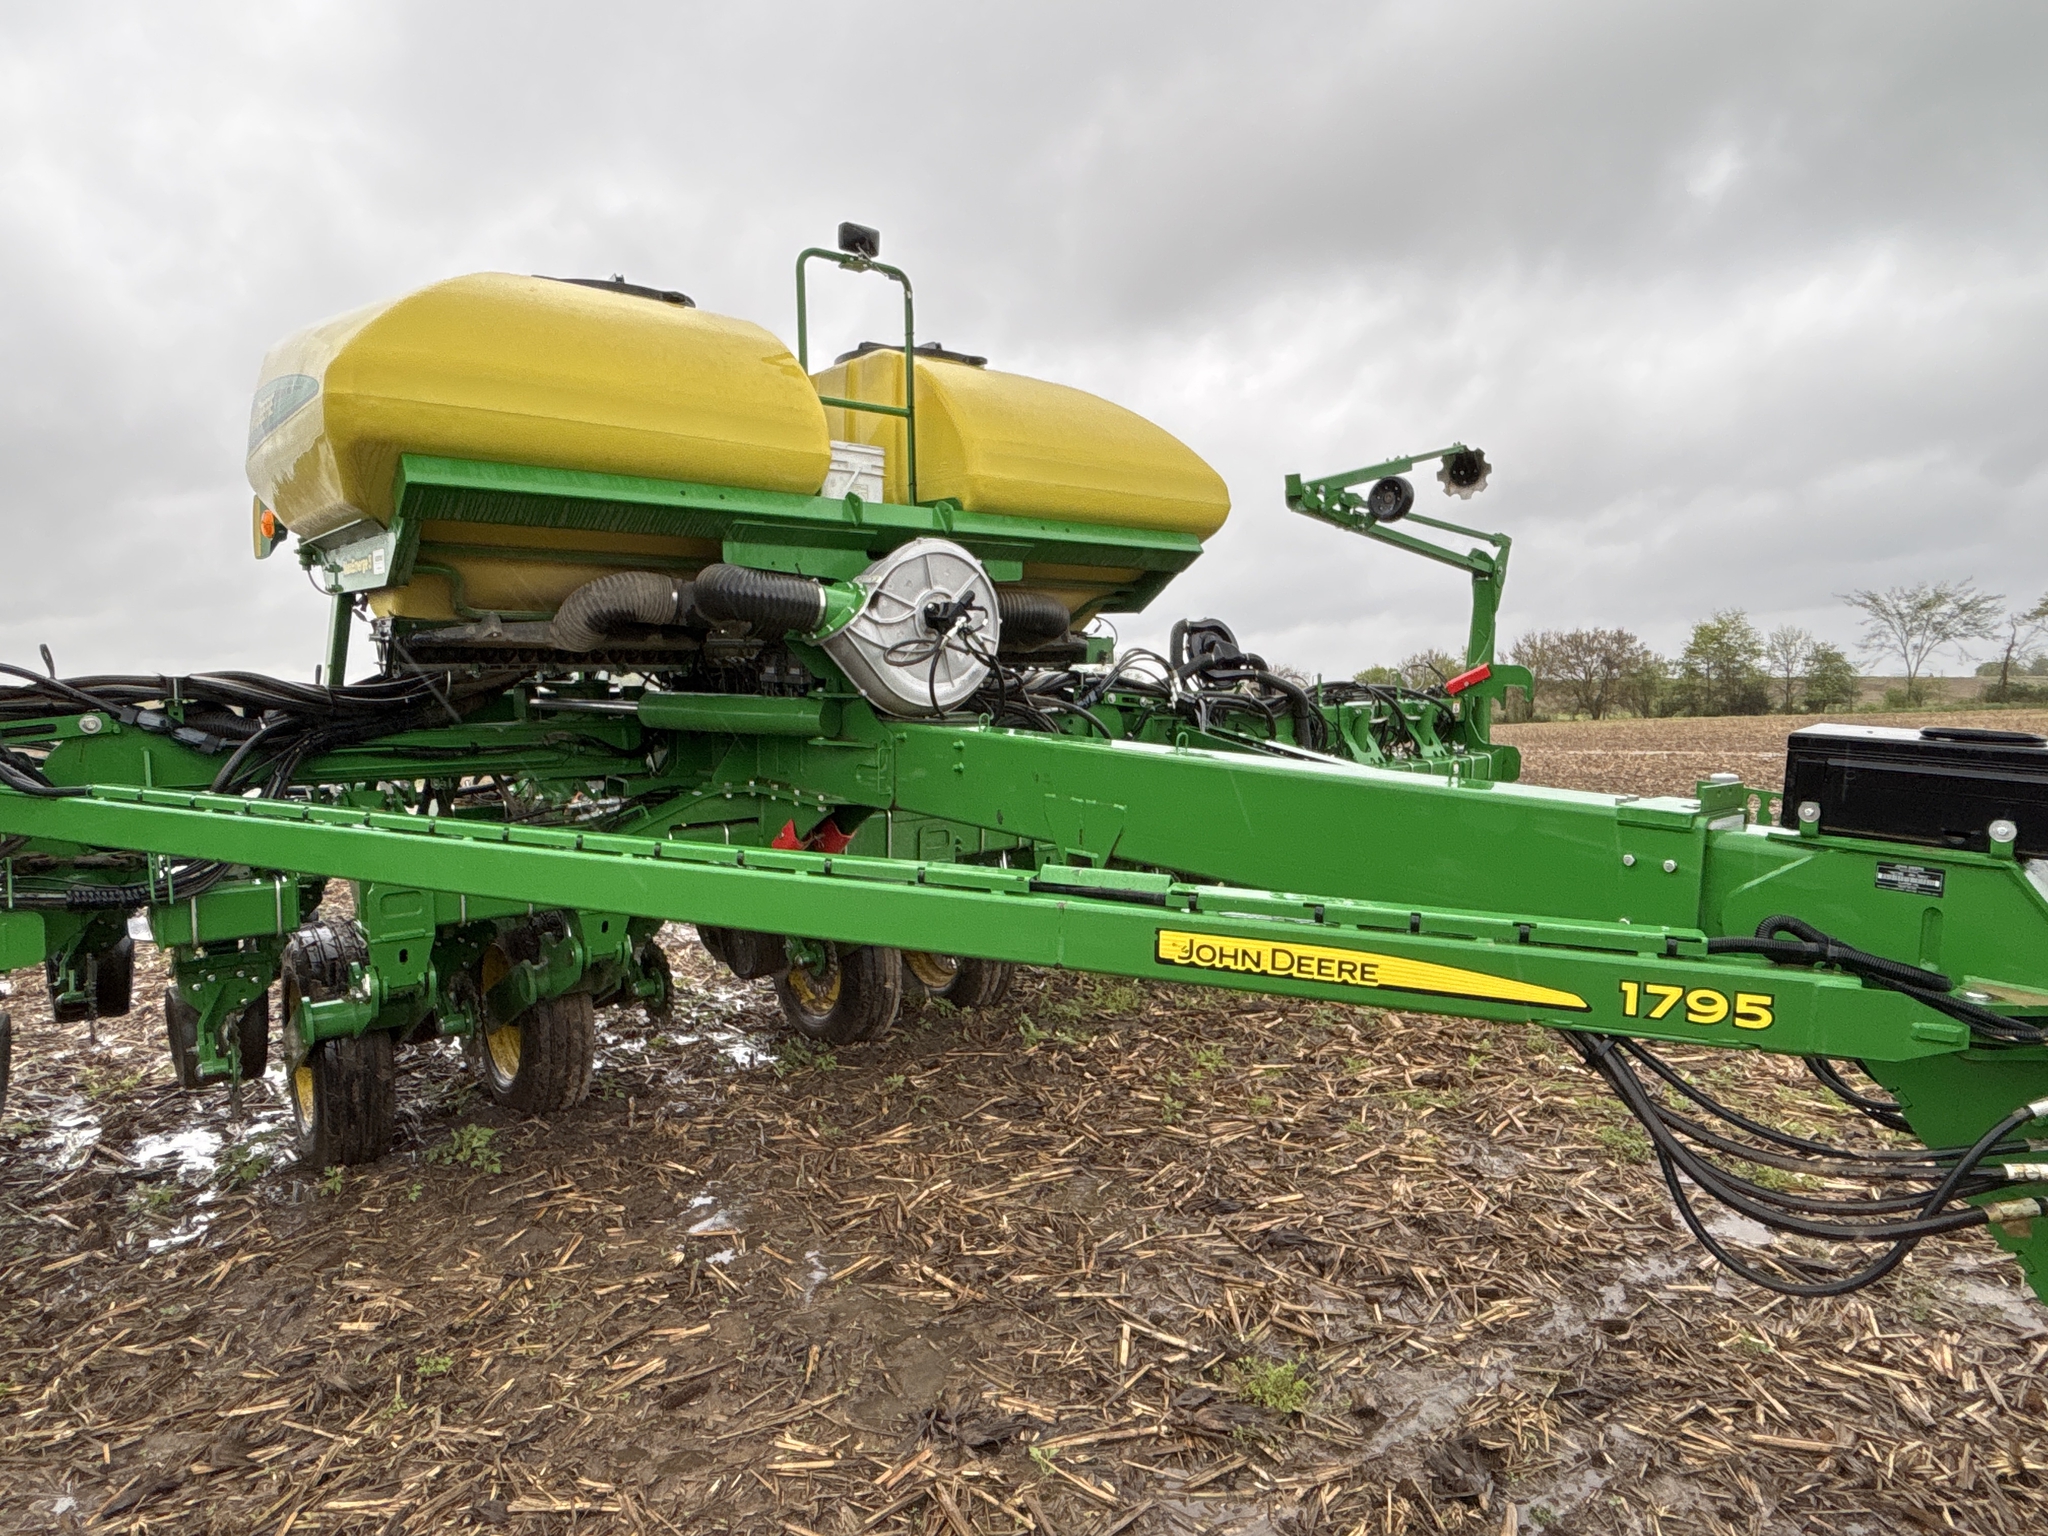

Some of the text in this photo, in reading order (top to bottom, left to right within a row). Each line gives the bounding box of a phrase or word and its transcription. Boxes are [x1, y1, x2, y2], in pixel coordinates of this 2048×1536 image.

[1178, 939, 1379, 983] JOHN DEERE
[1620, 980, 1774, 1030] 1795
